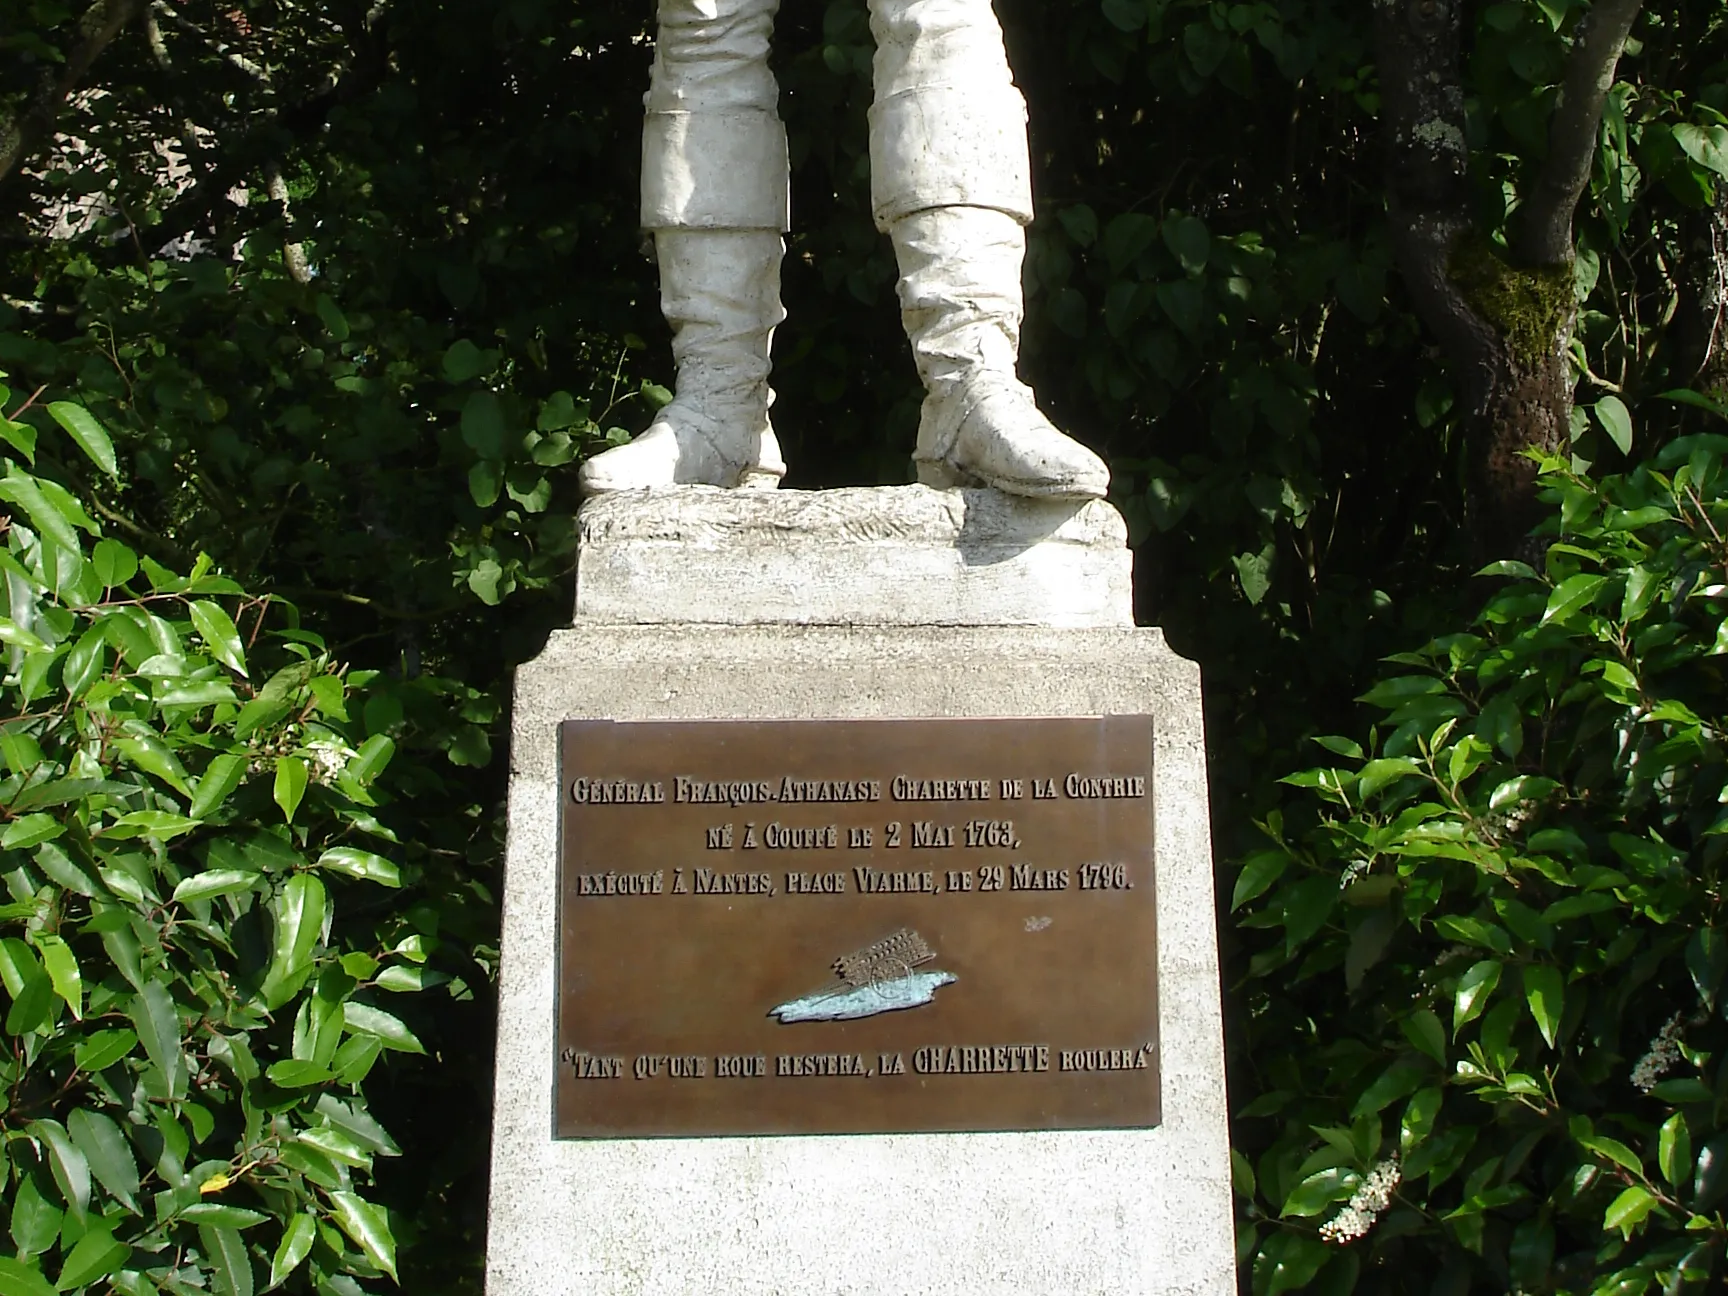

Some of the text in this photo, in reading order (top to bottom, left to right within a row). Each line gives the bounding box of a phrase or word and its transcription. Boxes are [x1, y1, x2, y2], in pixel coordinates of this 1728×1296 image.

[571, 777, 664, 803] GÉNÉRAL
[891, 774, 991, 801] CHARETTE
[1000, 778, 1023, 800] DE
[1032, 778, 1058, 799] LA
[1065, 772, 1145, 799] CONTRIE
[707, 820, 1021, 850] NÉ À COUFFÉ LE 2 MAI 1763,
[577, 869, 664, 896] EXÉCUTÉ
[671, 868, 687, 896] À
[694, 868, 778, 898] NANTES,
[785, 873, 846, 894] PLACE
[853, 866, 942, 894] VIARME,
[946, 871, 972, 891] LE
[978, 865, 1005, 891] 29
[1010, 864, 1070, 891] MARS
[715, 1056, 766, 1078] ROUE
[776, 1053, 873, 1078] RESTERA,
[877, 1053, 905, 1076] LA
[913, 1045, 1049, 1074] CHARRETTE
